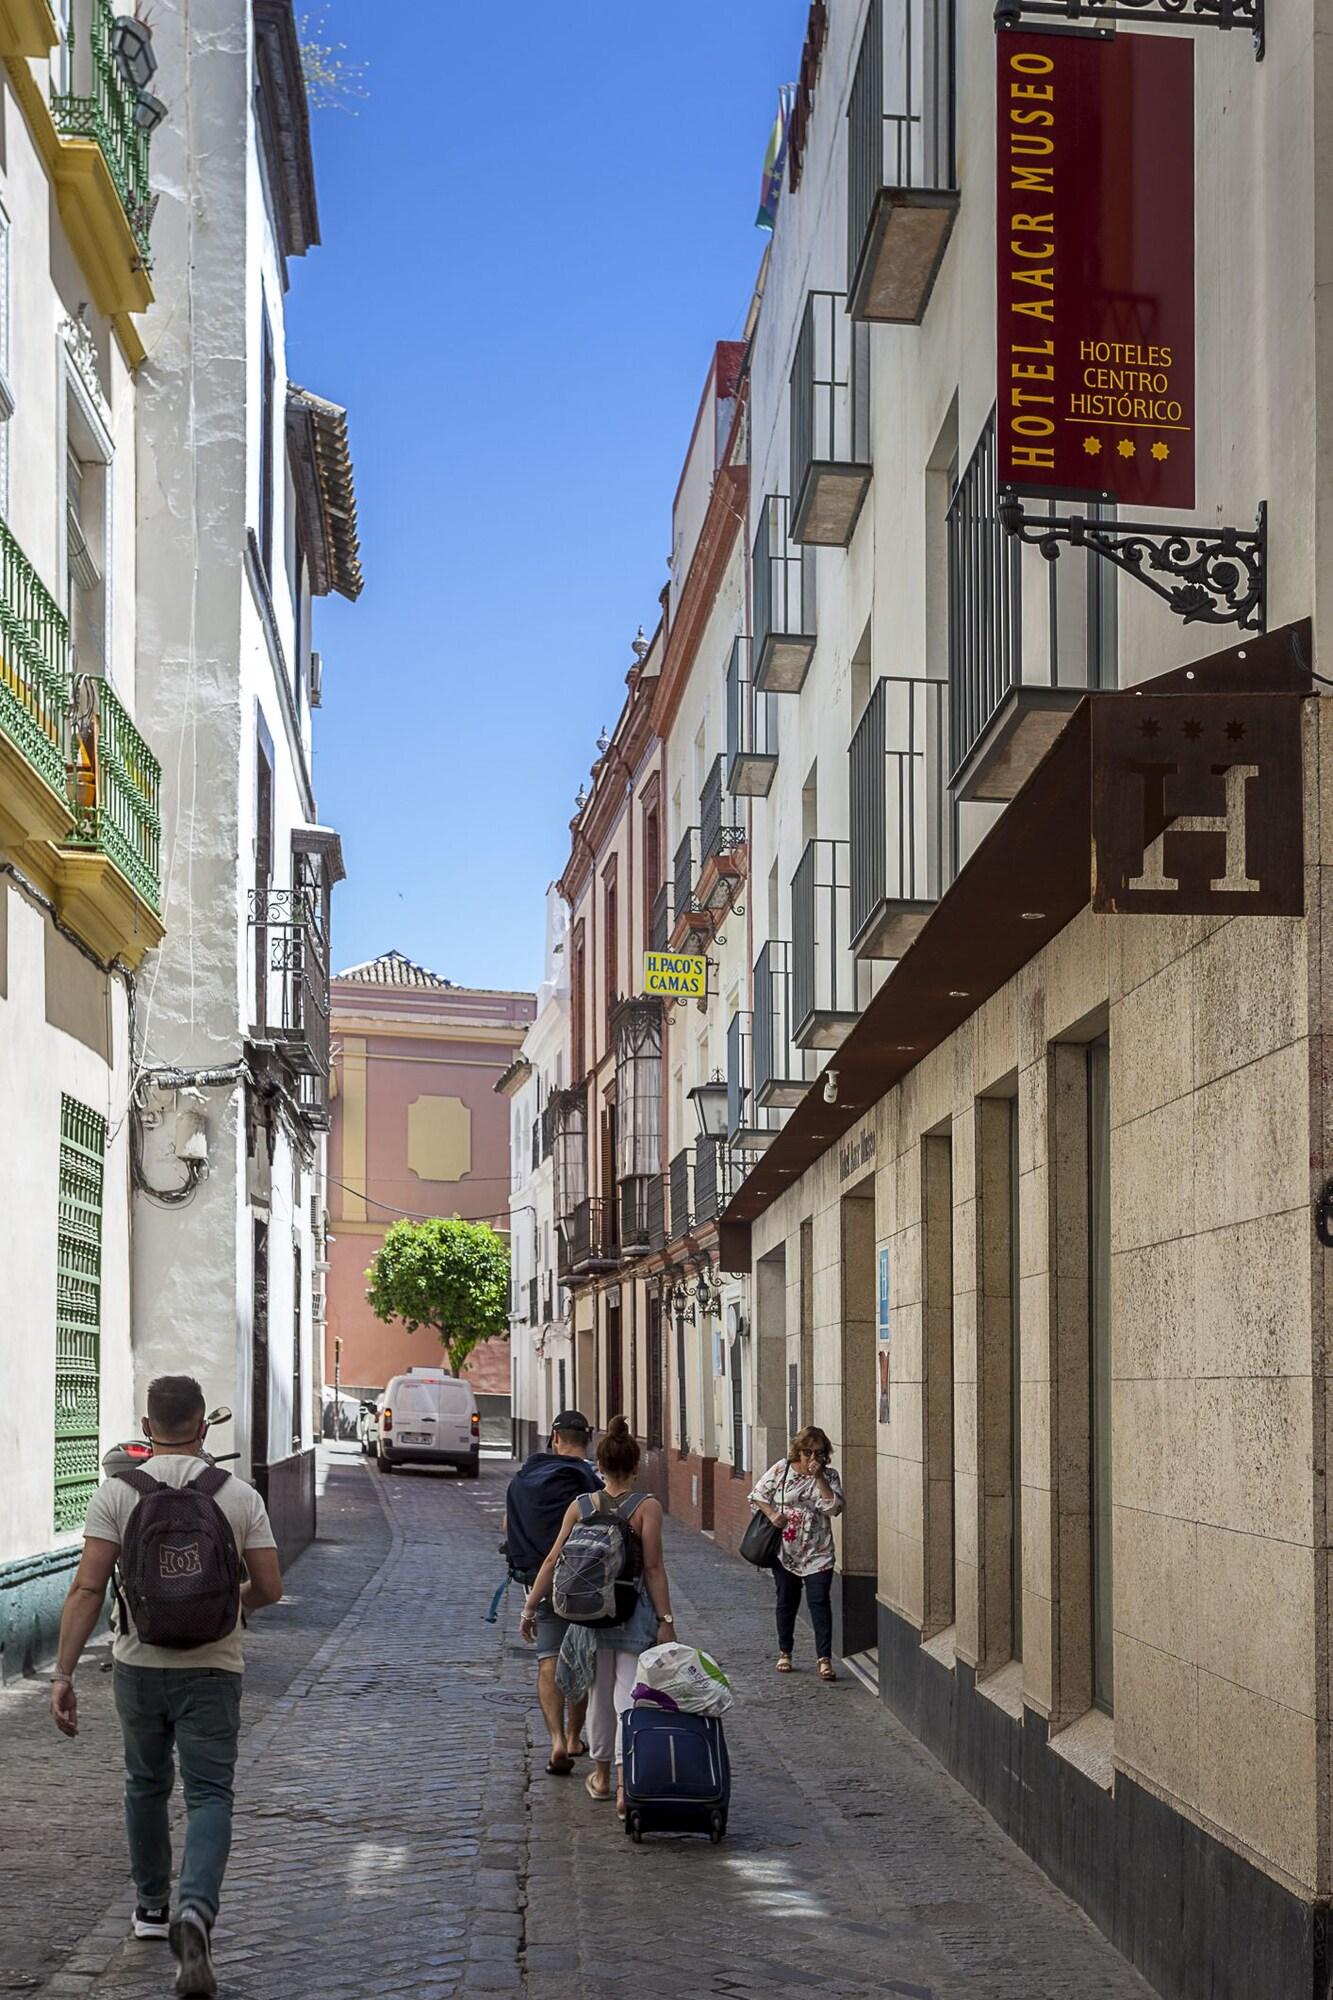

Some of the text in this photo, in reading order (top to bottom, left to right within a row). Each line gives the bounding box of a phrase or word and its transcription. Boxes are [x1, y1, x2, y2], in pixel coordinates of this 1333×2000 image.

[1010, 52, 1055, 469] HOTEL AACR MUSEO
[1079, 340, 1173, 368] HOTELES
[1083, 367, 1169, 394] CENTRO
[1070, 392, 1183, 422] HISTÓRICO
[1128, 761, 1261, 893] H
[649, 974, 700, 993] CAMAS
